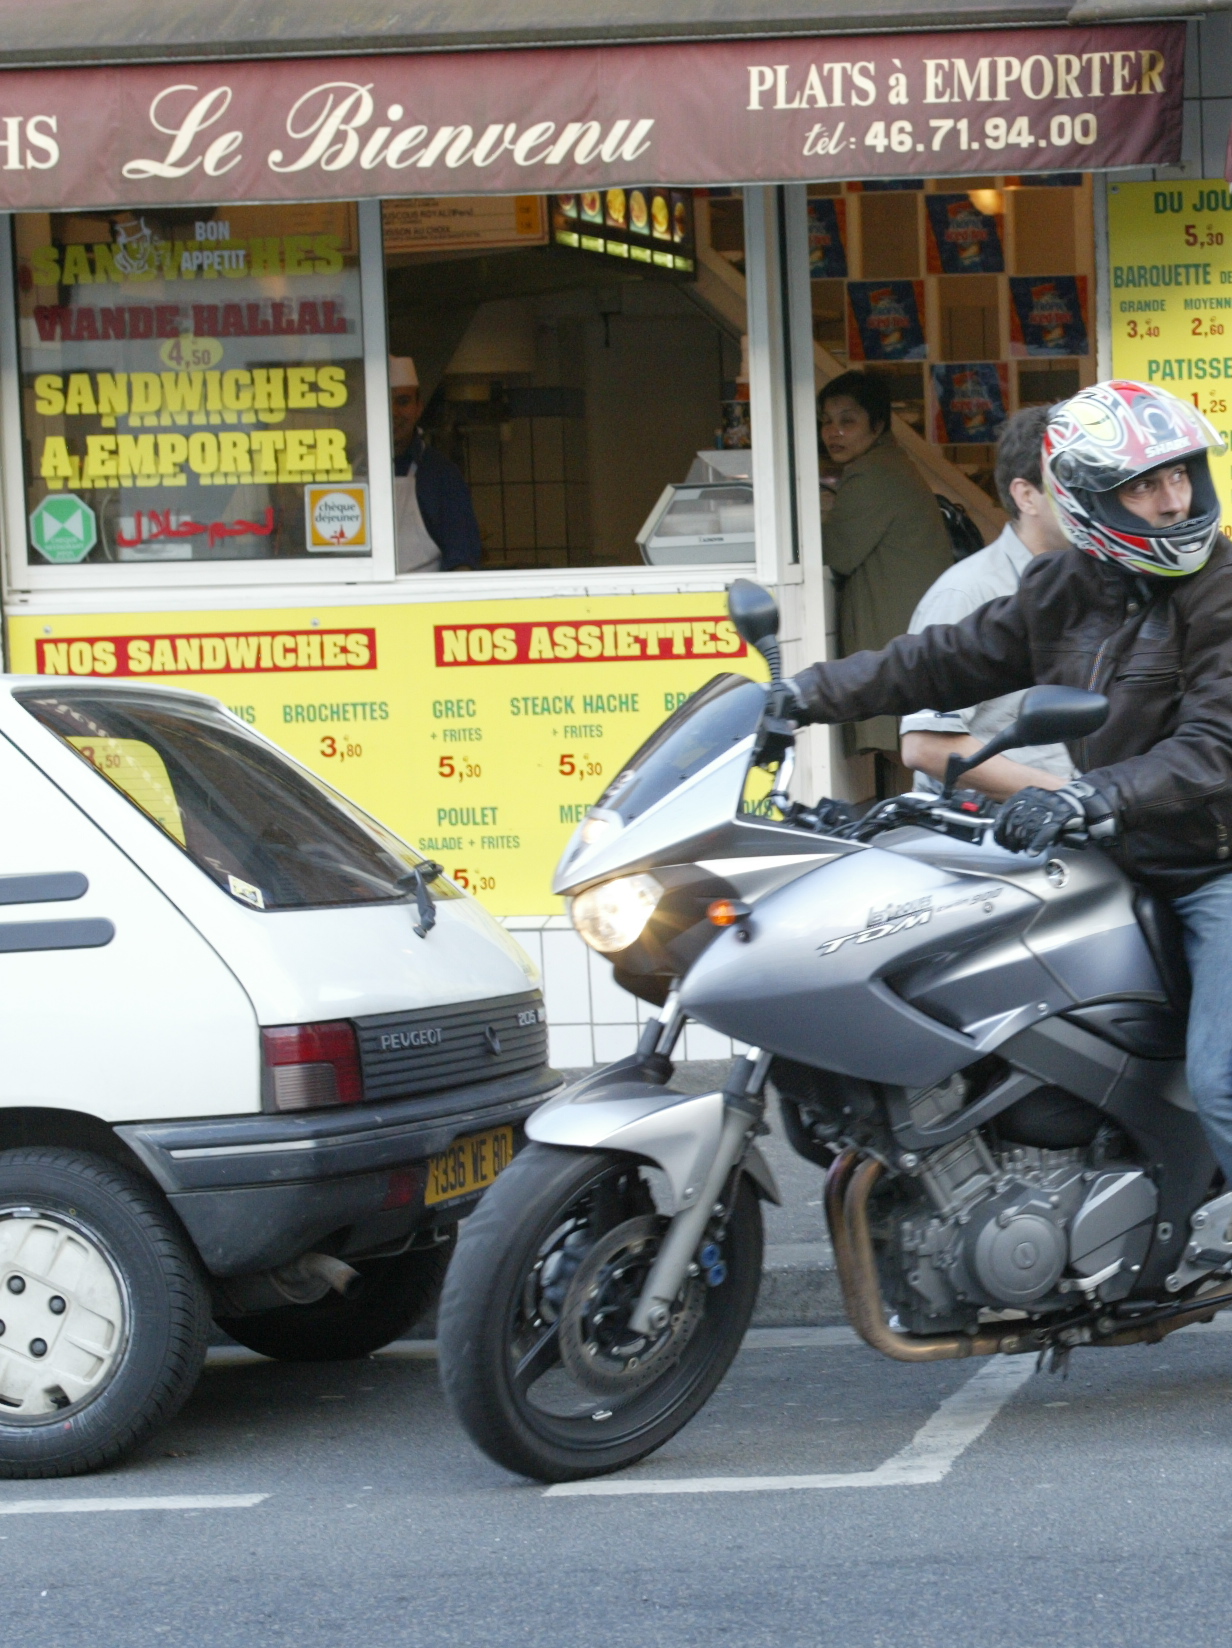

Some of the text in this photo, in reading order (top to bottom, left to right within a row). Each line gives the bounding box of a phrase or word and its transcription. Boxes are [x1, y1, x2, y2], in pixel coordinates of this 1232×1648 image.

[746, 49, 1167, 110] PLATS à EMPORTER
[122, 84, 243, 179] Le
[267, 81, 655, 173] Bienvenu
[864, 112, 1098, 153] 46.71.94.00
[1154, 191, 1183, 214] DU
[195, 221, 230, 241] BON
[1184, 224, 1224, 249] 5,30
[180, 250, 247, 271] APPETIT
[1113, 263, 1211, 288] BARQUETTE
[1220, 271, 1232, 284] DE
[1119, 299, 1166, 312] GRANDE
[33, 299, 347, 342] VIANDE HALLAL
[1126, 320, 1160, 339] 3,40
[1191, 317, 1225, 338] 2,60
[168, 336, 212, 369] 4,50
[34, 366, 348, 416] SANDWICHES
[40, 428, 351, 477] A EMPORTER
[1144, 435, 1192, 459] SHARK
[44, 633, 371, 674] NOS SANDWICHES
[442, 620, 741, 663] NOS ASSIETTES
[282, 702, 390, 723] BROCHETTES
[432, 699, 477, 718] GREC
[510, 693, 639, 716] STEACK HACHE
[443, 728, 483, 743] FRITES
[563, 724, 603, 739] FRITES
[319, 737, 363, 762] 3,80
[437, 756, 482, 782] 5,30
[557, 754, 603, 780] 5,30
[437, 807, 499, 826] POULET
[418, 837, 463, 851] SALADE
[480, 836, 521, 850] FRITES
[452, 868, 496, 893] 5,30
[816, 909, 934, 957] TDM
[518, 1011, 537, 1026] 205
[381, 1028, 443, 1050] PEUGEOT
